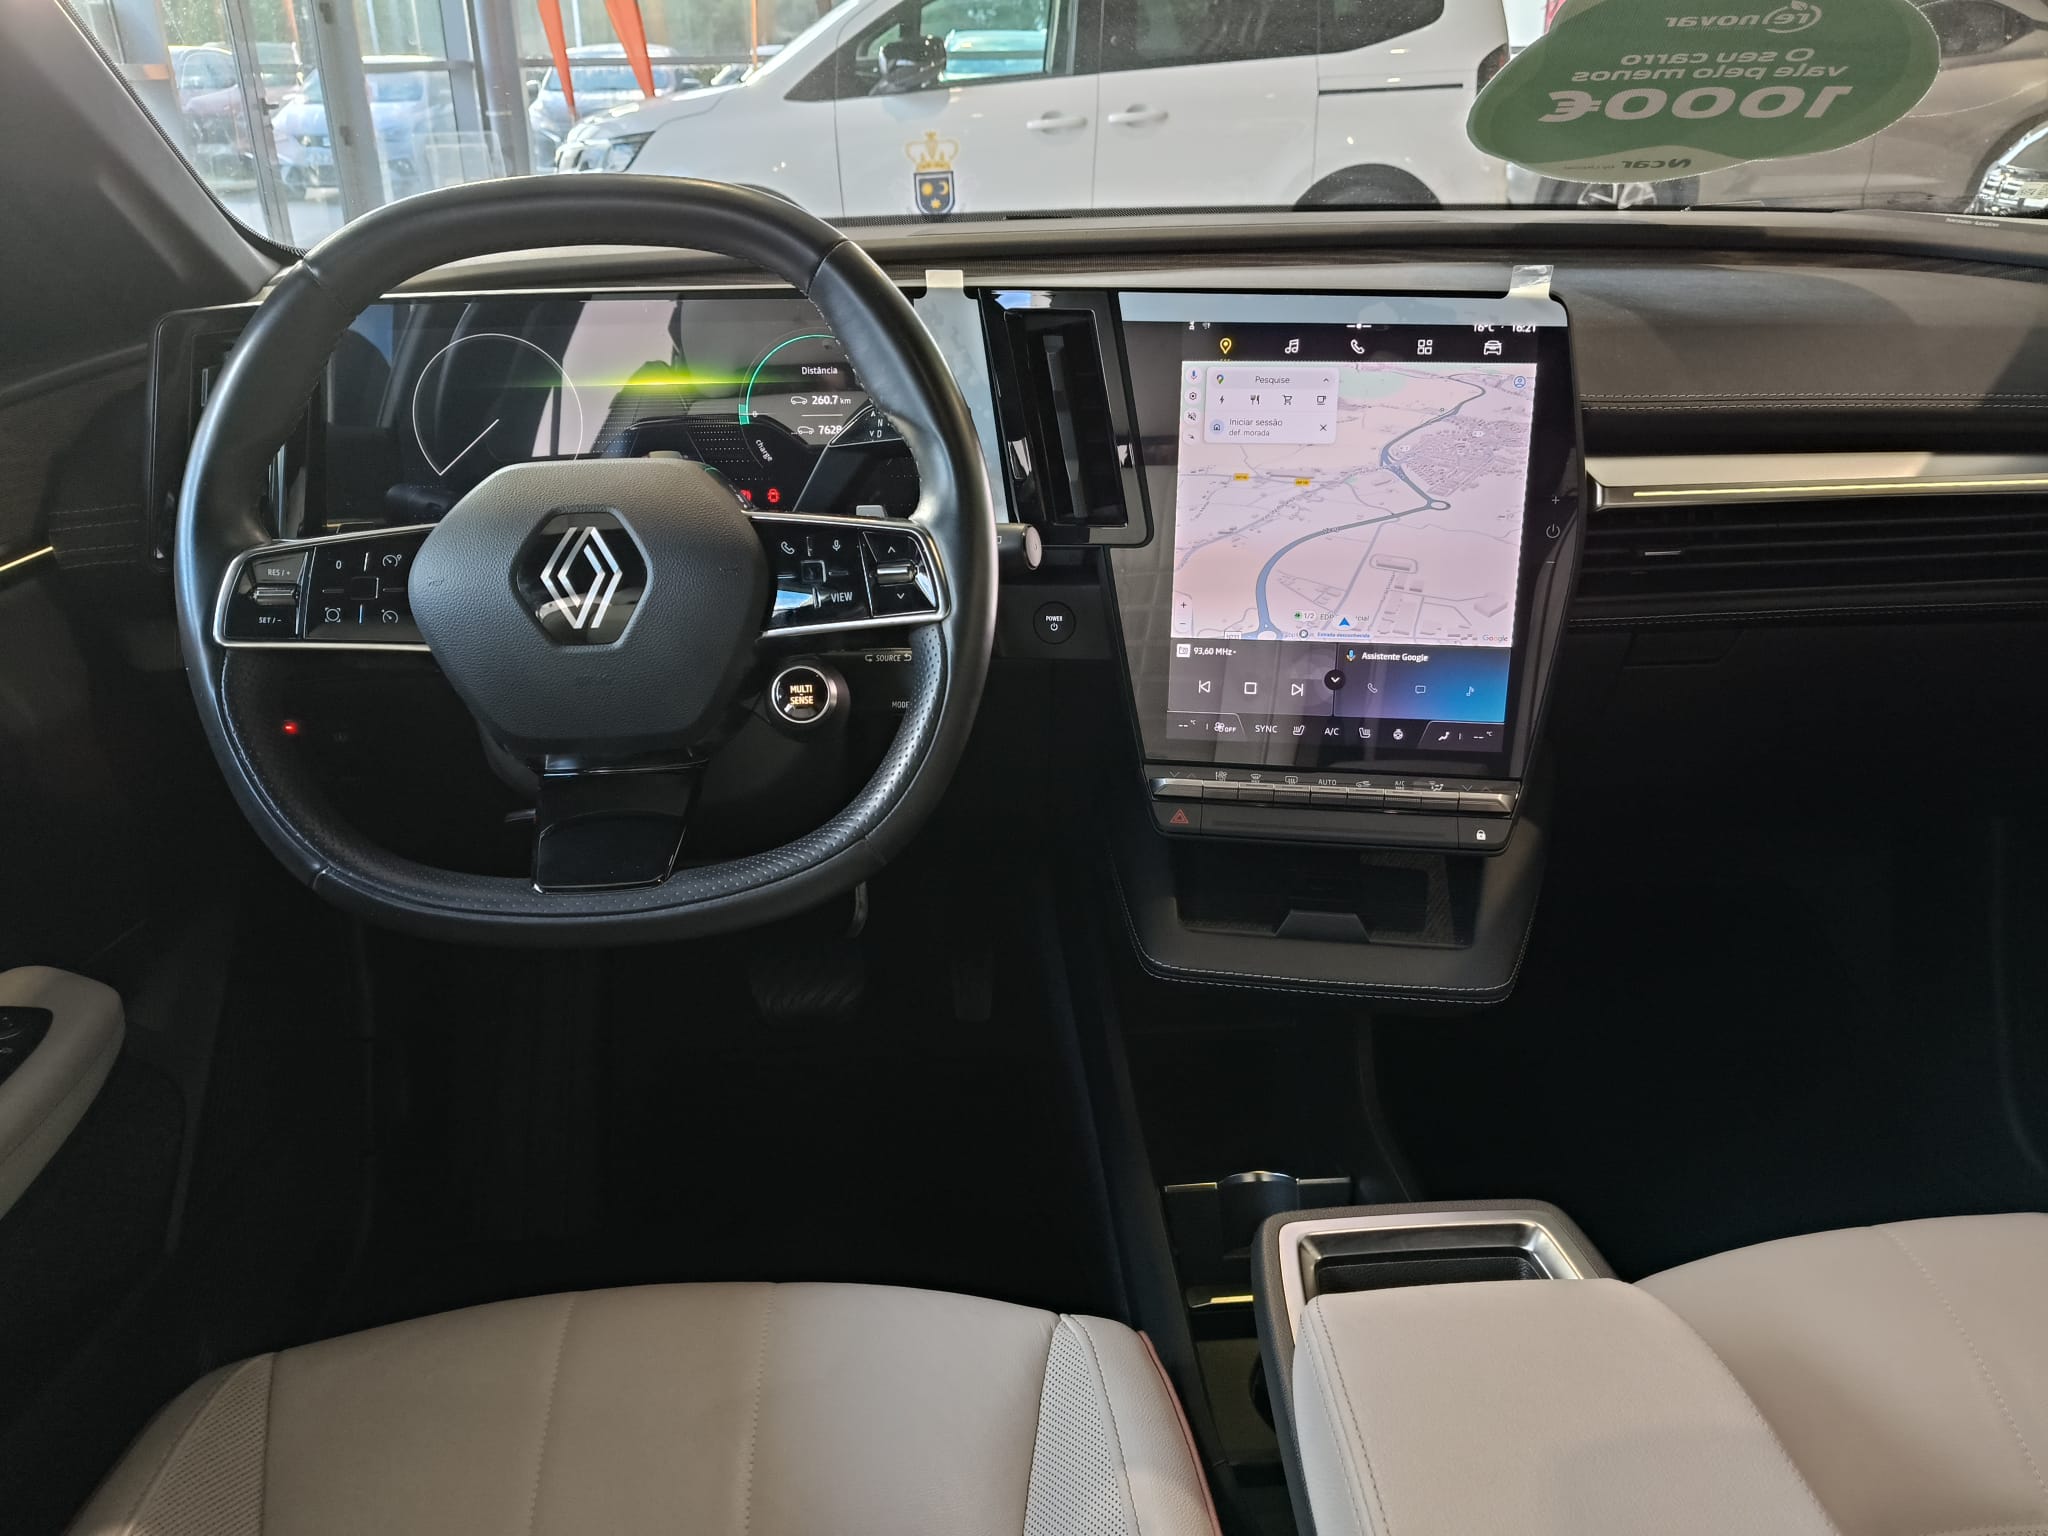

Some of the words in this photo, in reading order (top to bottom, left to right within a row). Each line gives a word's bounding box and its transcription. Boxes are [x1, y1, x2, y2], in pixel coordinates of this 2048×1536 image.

[801, 366, 838, 375] Distância
[1255, 376, 1290, 385] Pesquise
[811, 395, 838, 405] 260.7
[1229, 418, 1253, 426] Iniciar
[1255, 418, 1283, 427] sessão
[267, 568, 281, 576] RES
[831, 592, 853, 603] VIEW
[1304, 611, 1315, 619] 1/2
[258, 616, 272, 624] SET
[1482, 634, 1508, 643] Google
[875, 654, 901, 662] SOURCE
[1362, 652, 1400, 661] Assistente
[1402, 653, 1429, 663] Google
[789, 685, 813, 694] MULTI
[789, 695, 814, 705] SENSE
[1255, 725, 1278, 733] SYNC
[1324, 728, 1340, 736] A/C
[1318, 778, 1337, 786] AUTO
